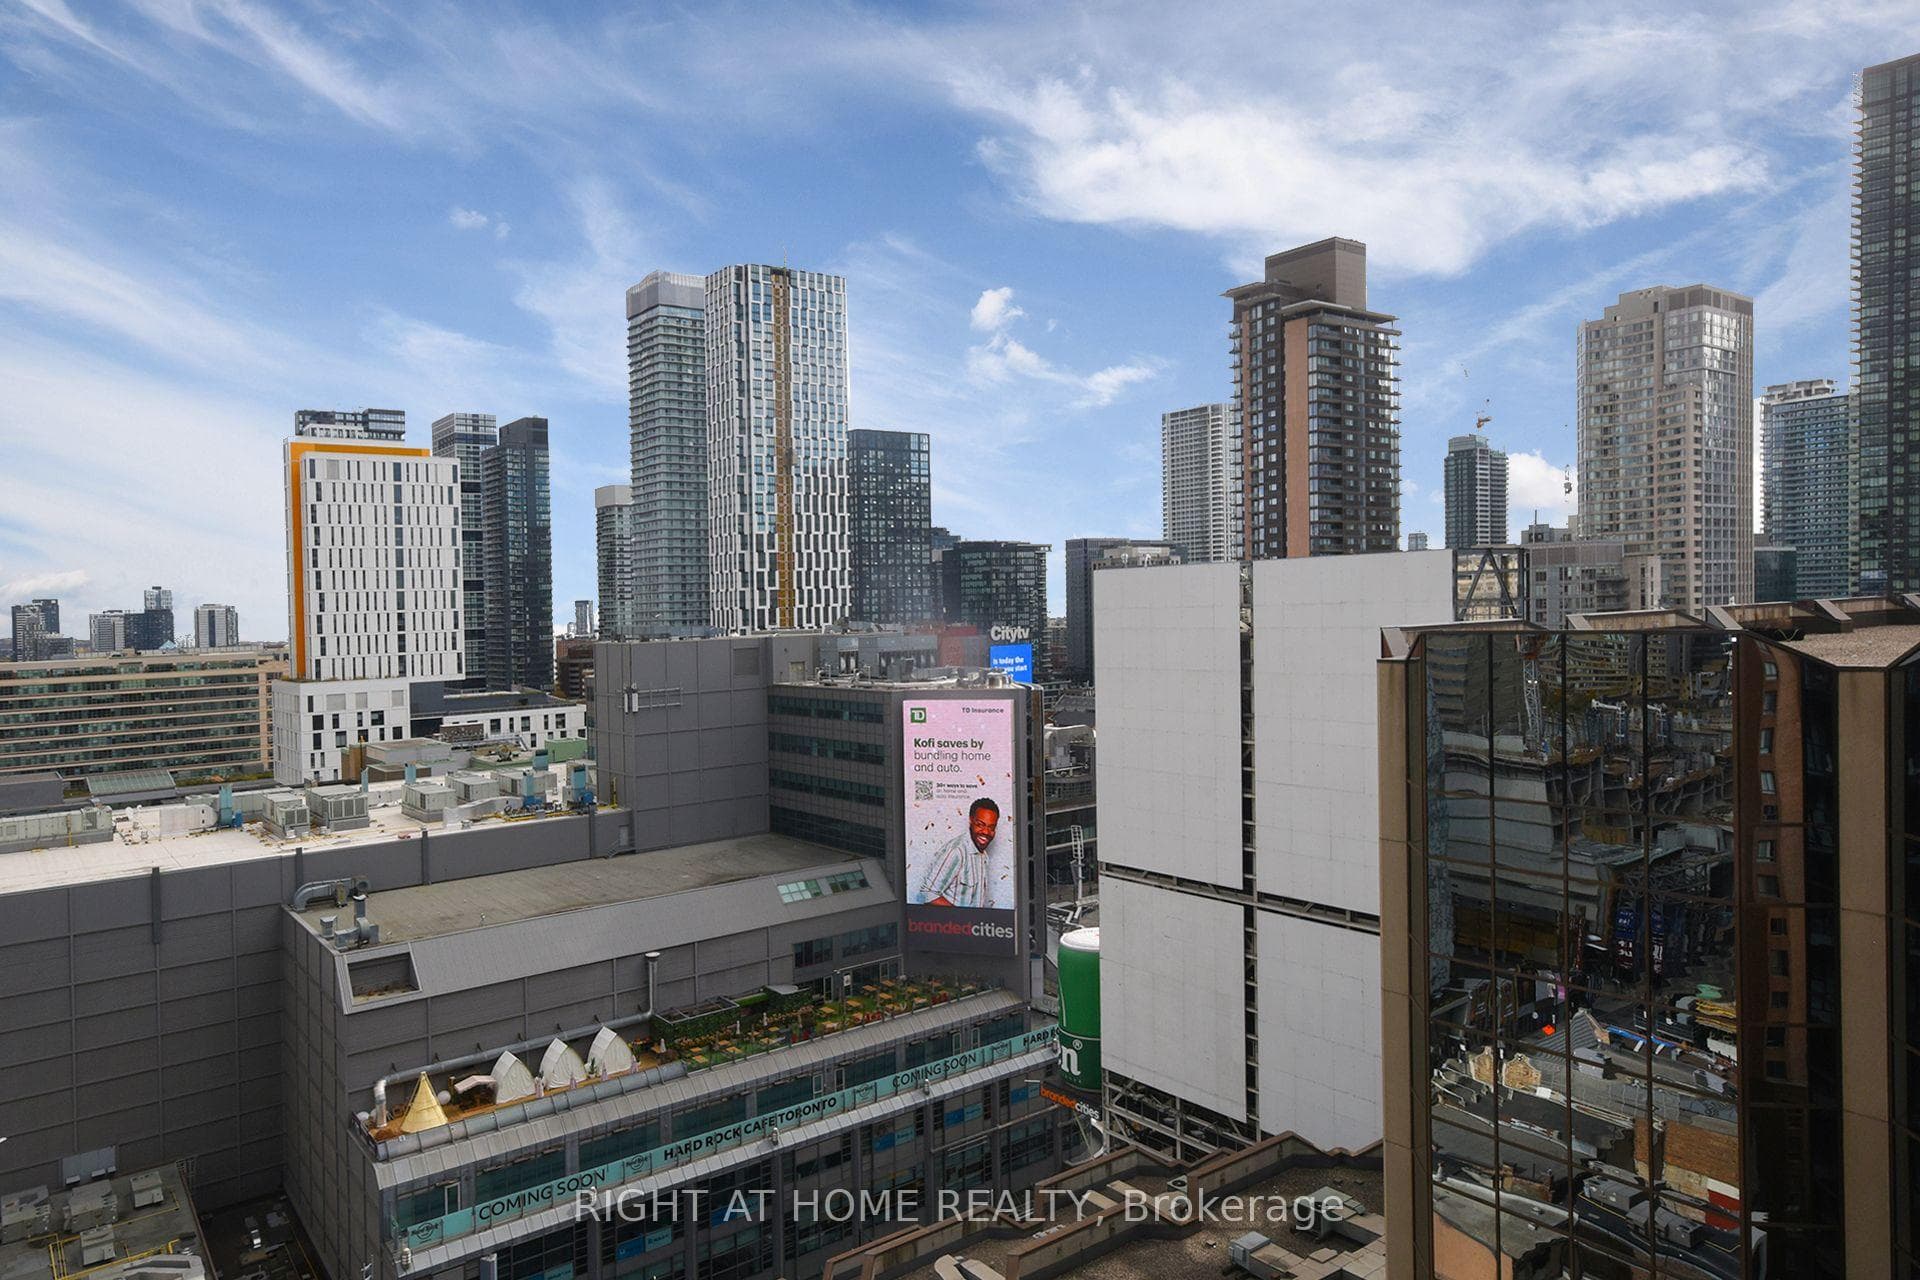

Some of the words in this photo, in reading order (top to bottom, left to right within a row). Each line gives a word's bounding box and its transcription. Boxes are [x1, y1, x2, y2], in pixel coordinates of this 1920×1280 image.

[991, 626, 1030, 643] Citytv
[911, 709, 925, 721] TD
[914, 738, 935, 748] Kofi
[937, 740, 969, 748] saves
[971, 738, 984, 750] by
[914, 750, 958, 762] bundling
[961, 751, 991, 761] home
[914, 763, 934, 772] and
[937, 764, 962, 773] auto.
[908, 918, 1014, 939] brandedcities
[1023, 1030, 1049, 1047] HARD
[893, 1063, 942, 1088] COMING
[944, 1052, 977, 1072] SOON
[664, 1139, 703, 1161] HARD
[705, 1126, 742, 1148] ROCK
[744, 1116, 775, 1135] CAFE
[778, 1097, 837, 1124] TORONTO
[479, 1184, 553, 1220] COMING
[556, 1169, 606, 1196] SOON
